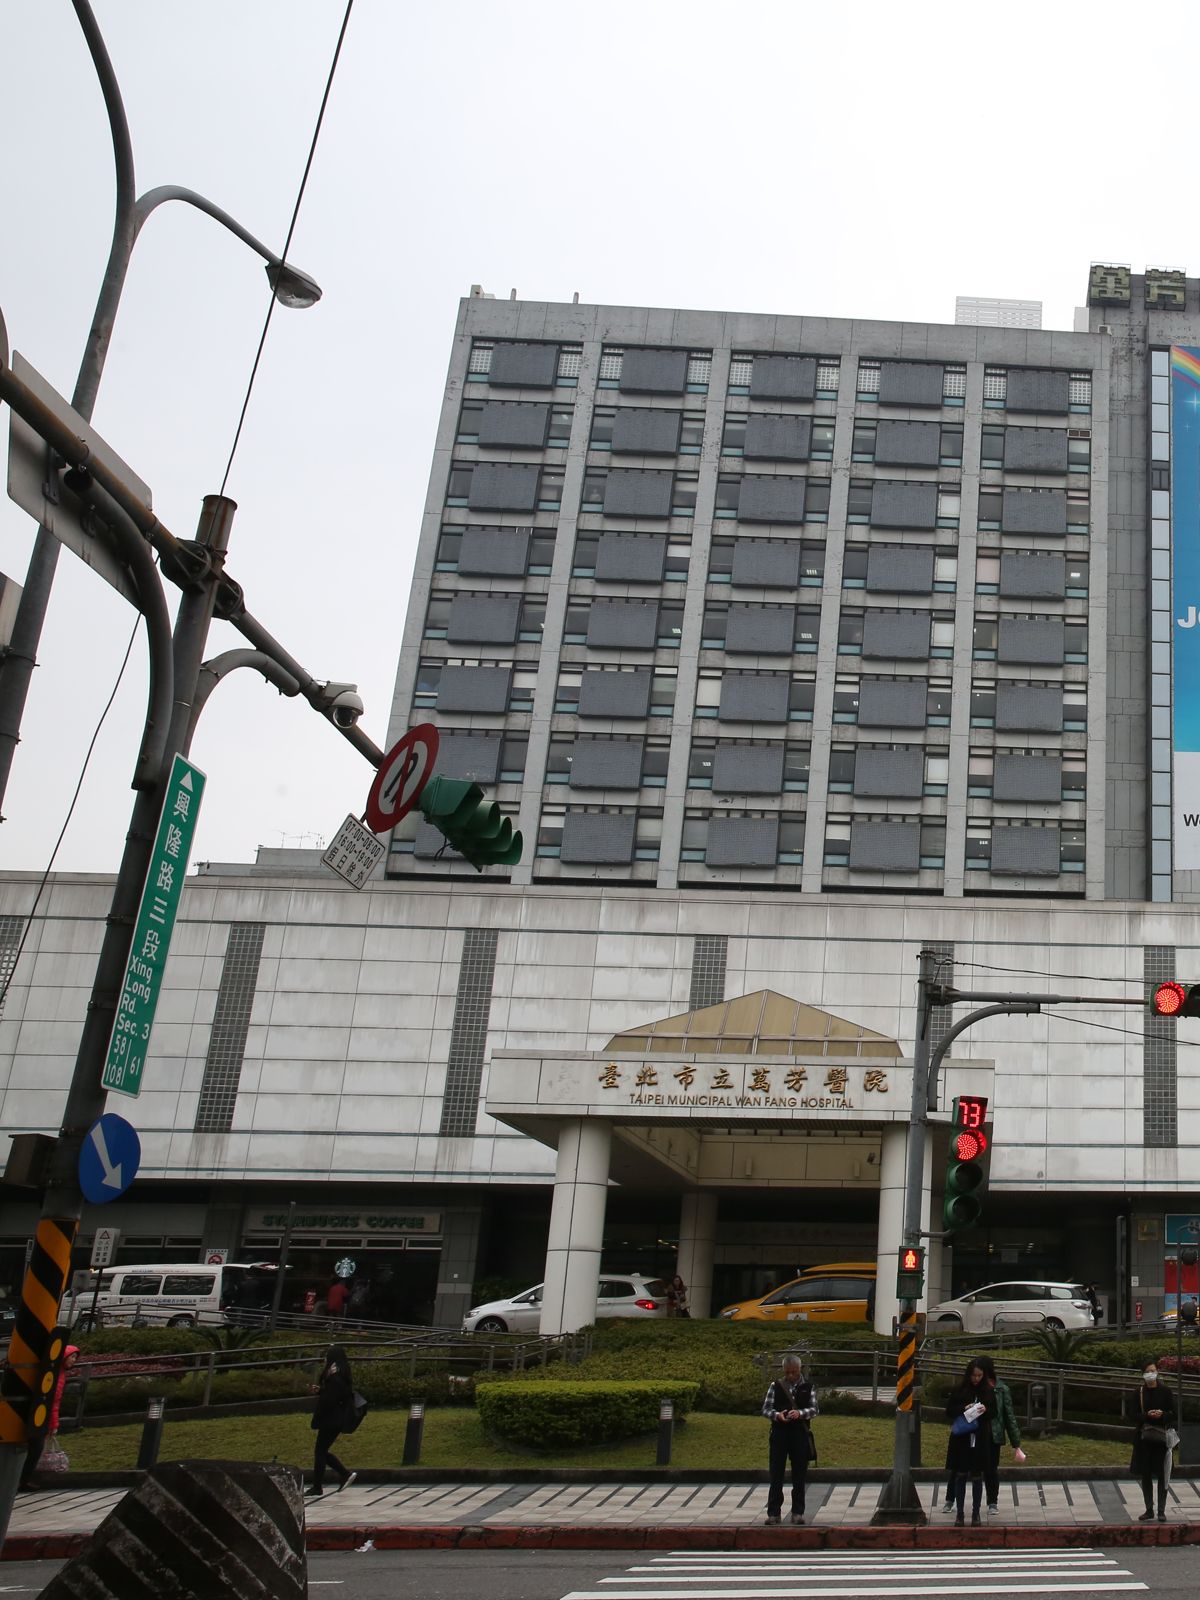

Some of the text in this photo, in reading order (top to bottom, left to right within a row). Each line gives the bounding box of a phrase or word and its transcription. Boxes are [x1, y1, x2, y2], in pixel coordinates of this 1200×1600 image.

[141, 790, 191, 961] 興隆路三段
[129, 955, 153, 984] Xing
[125, 974, 151, 1004] Long
[121, 993, 136, 1015] Rd.
[117, 1013, 150, 1040] Sec. 3
[114, 1034, 127, 1056] 58
[105, 1063, 123, 1086] 108
[130, 1056, 141, 1076] 61
[599, 1062, 888, 1094] 臺北市立萬芳醫院
[630, 1094, 853, 1108] TAIPEI MUNICIPAL WAN FANG HOSPITAL
[959, 1102, 981, 1128] 73
[366, 1216, 425, 1228] COFFEE
